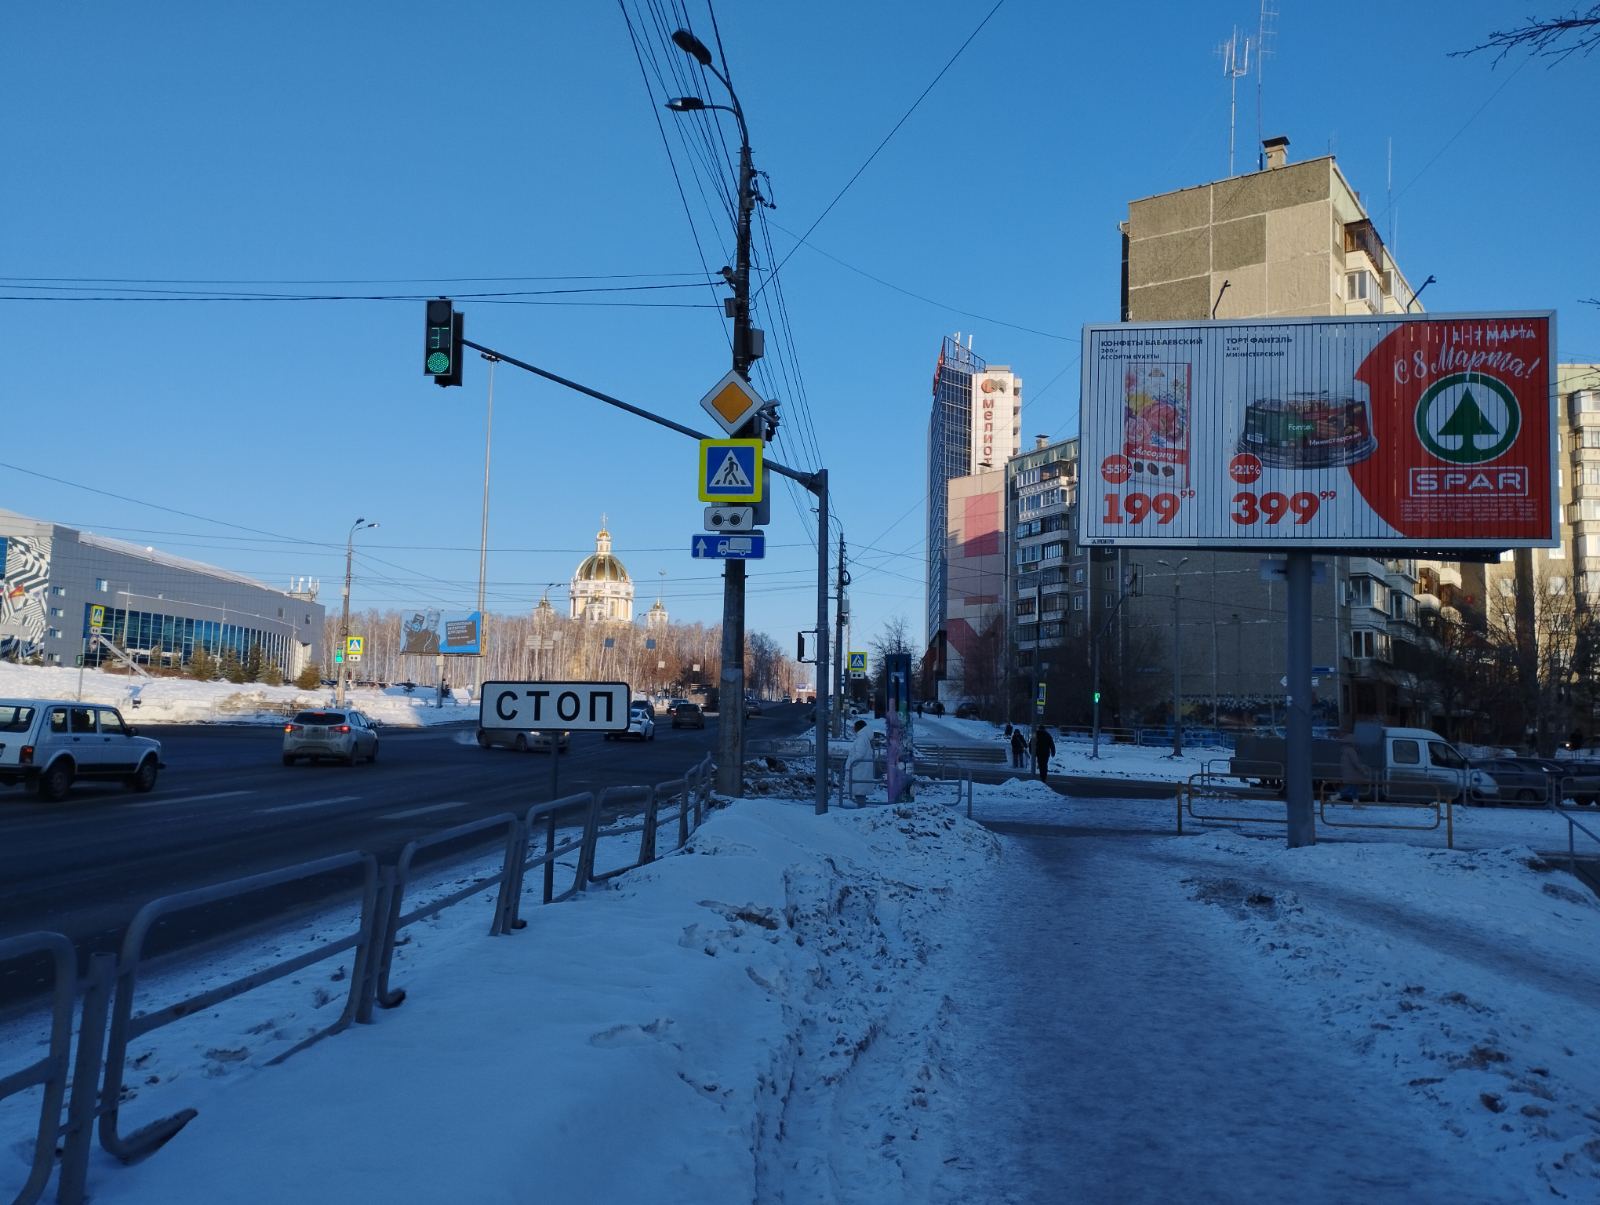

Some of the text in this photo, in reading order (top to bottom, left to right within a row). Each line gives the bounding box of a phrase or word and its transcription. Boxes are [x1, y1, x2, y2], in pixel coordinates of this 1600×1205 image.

[1145, 338, 1203, 346] БАБАЕВСКИЙ
[1487, 327, 1537, 341] МАРТА
[1413, 350, 1428, 379] 8
[1416, 472, 1521, 491] SPAR
[1103, 492, 1180, 525] 199
[1231, 491, 1319, 526] 399
[496, 690, 614, 722] СТОП
